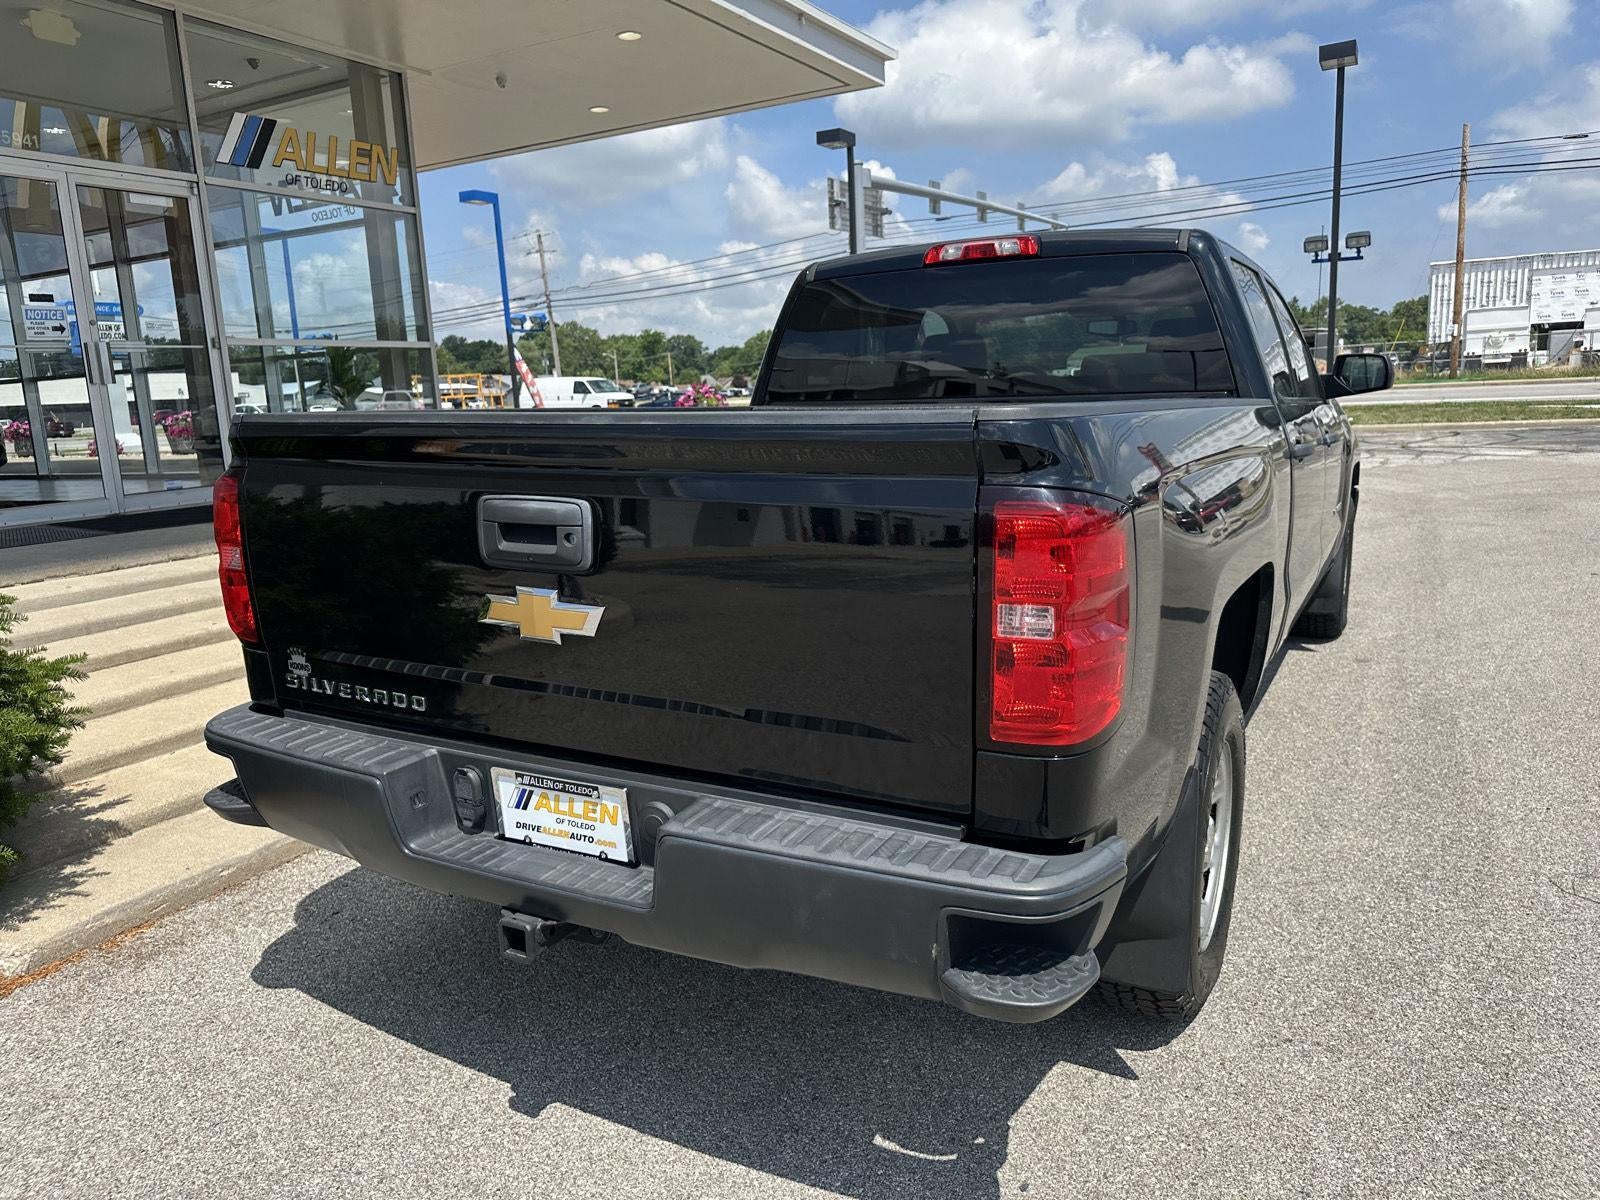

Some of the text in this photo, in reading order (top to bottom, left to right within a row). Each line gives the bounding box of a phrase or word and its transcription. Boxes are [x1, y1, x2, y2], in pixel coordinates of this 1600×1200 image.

[0, 130, 40, 149] 5941
[272, 127, 398, 186] ALLEN
[285, 173, 348, 193] OF TOLEDO
[27, 310, 63, 320] NOTICE
[285, 673, 426, 712] SILVERADO
[529, 777, 593, 795] ALLEN OF TOLEDO
[534, 791, 620, 827] ALLEN
[555, 817, 596, 831] OF TOLEDO
